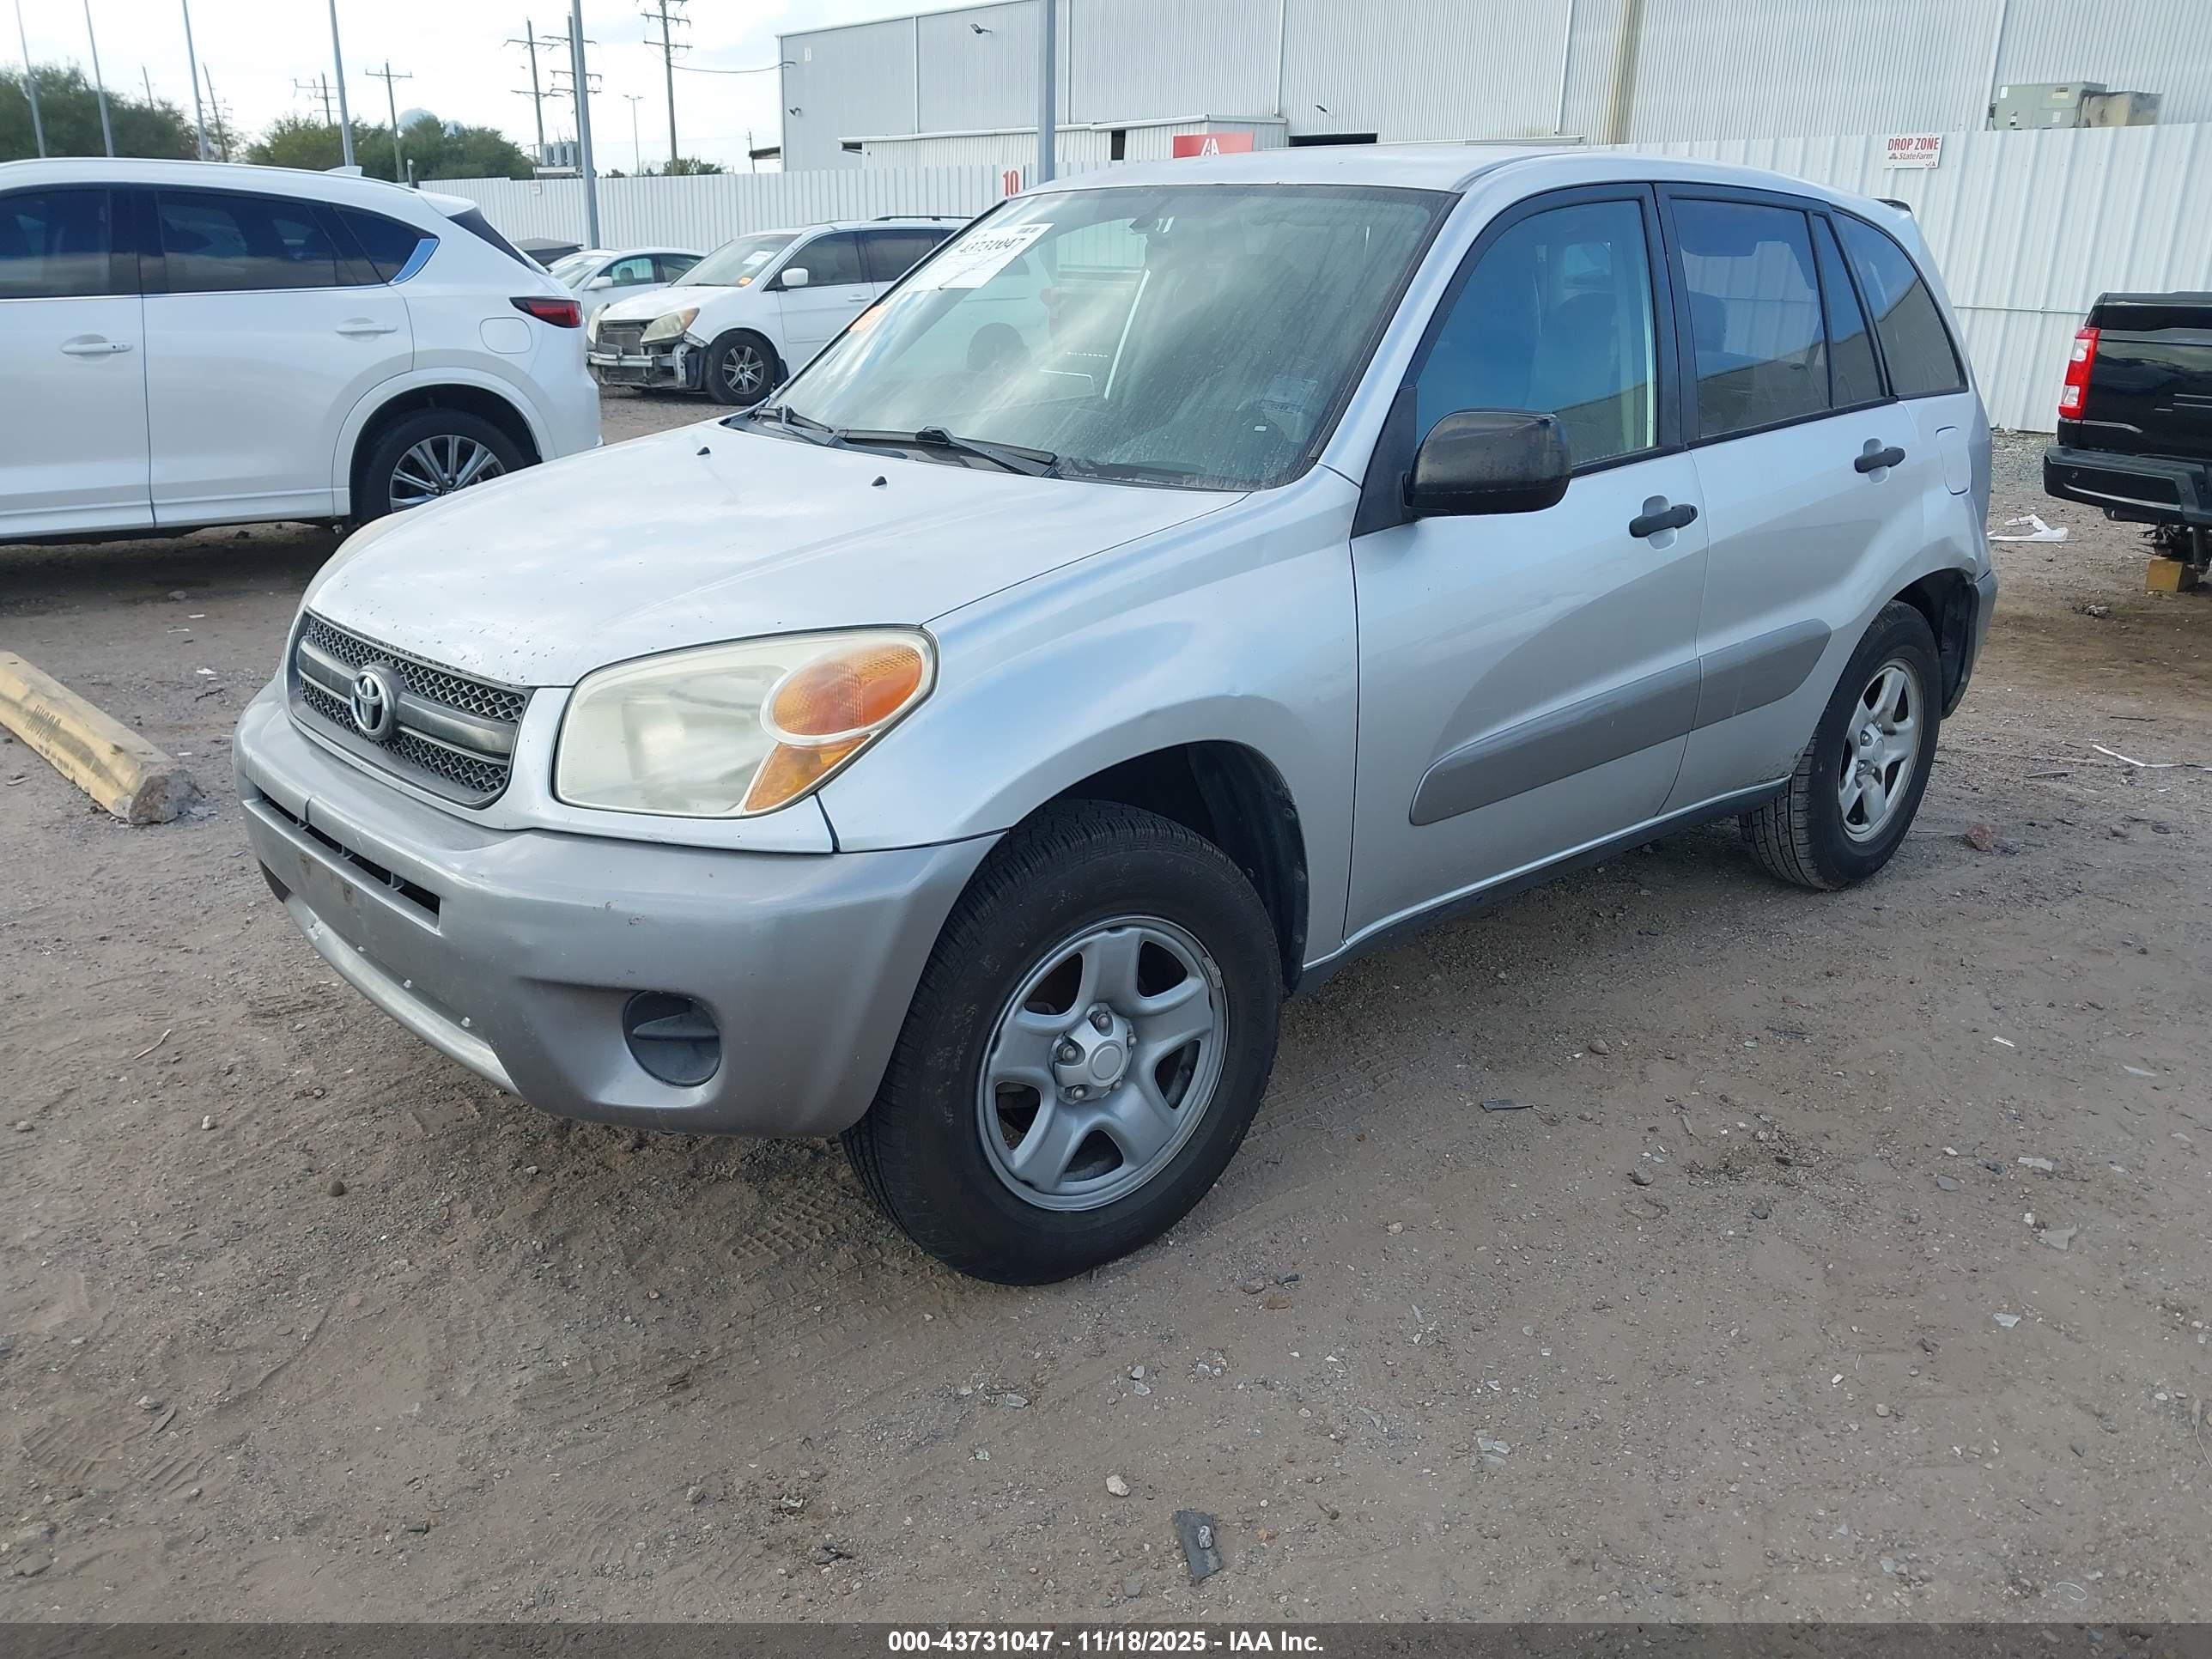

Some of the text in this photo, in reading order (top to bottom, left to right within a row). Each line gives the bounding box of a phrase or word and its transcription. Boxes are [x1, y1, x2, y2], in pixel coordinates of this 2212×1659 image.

[1887, 137, 1940, 150] DROP ZONE
[1003, 170, 1019, 197] 10
